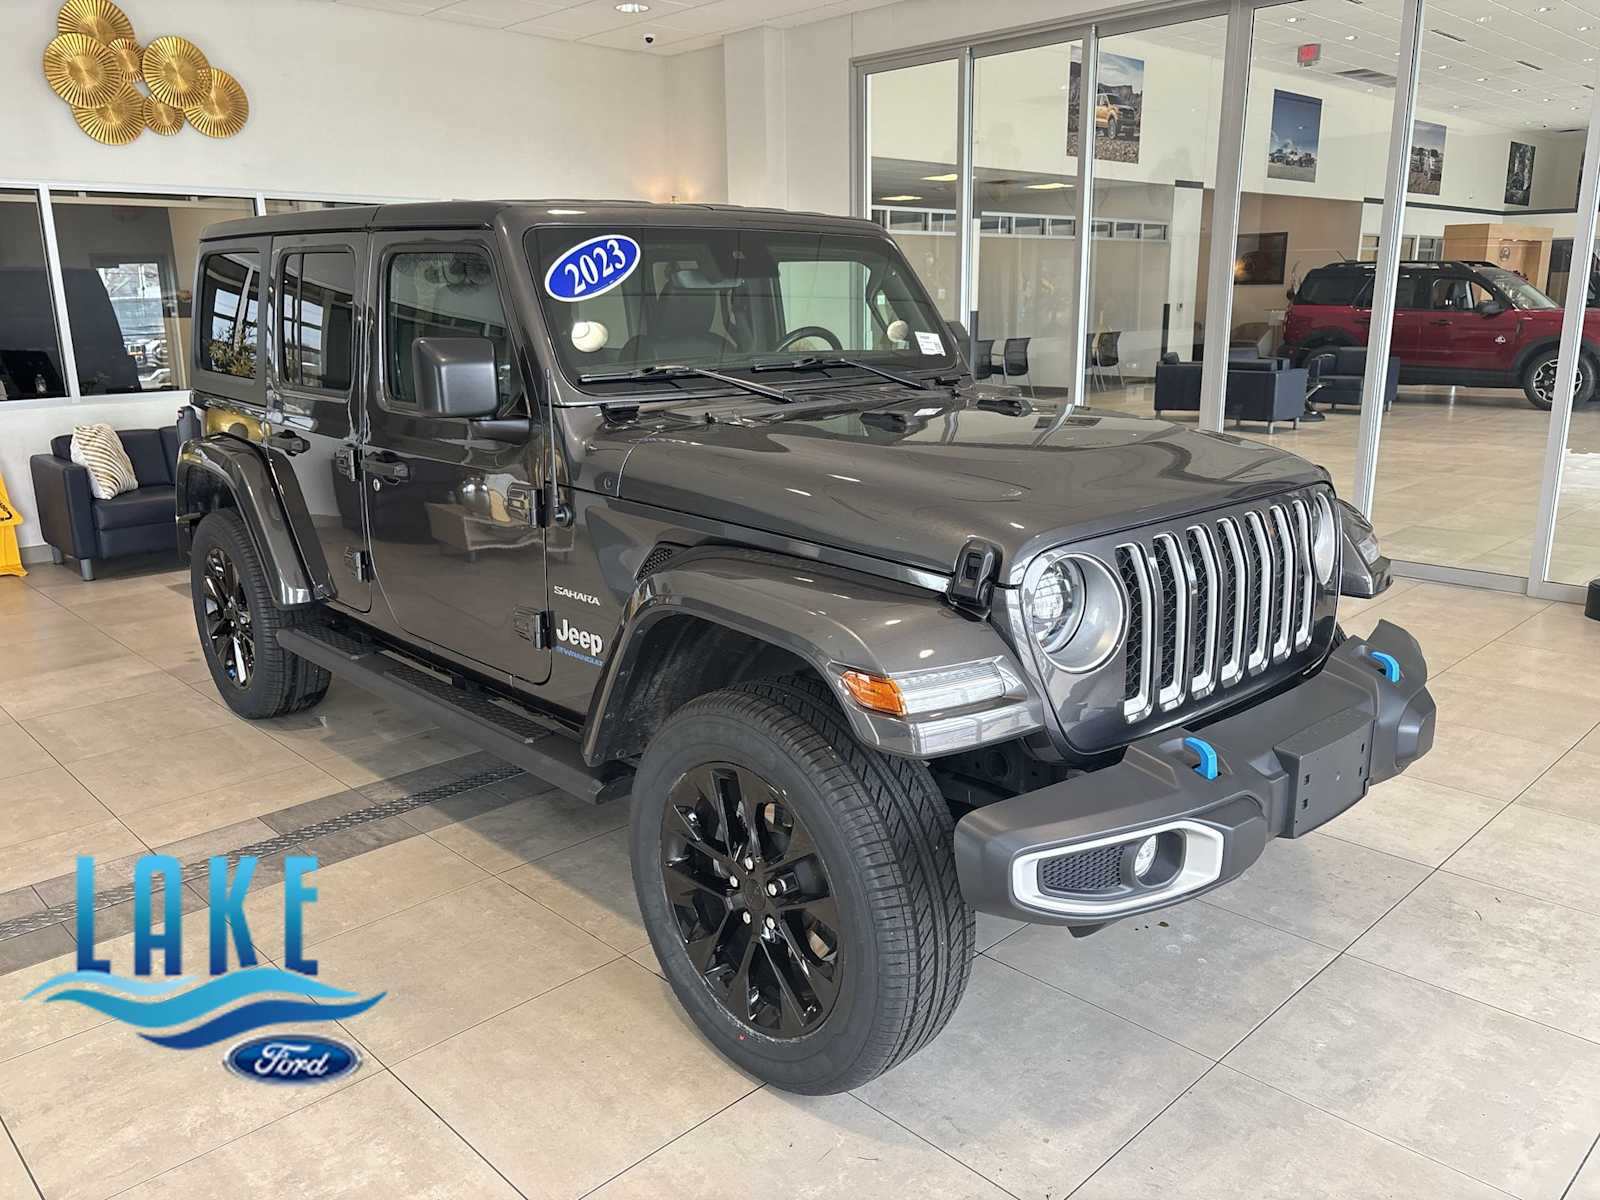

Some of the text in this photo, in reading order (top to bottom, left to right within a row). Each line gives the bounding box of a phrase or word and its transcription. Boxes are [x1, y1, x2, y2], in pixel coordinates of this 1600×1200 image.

[564, 239, 626, 295] 2023
[554, 585, 600, 606] SAHARA
[556, 618, 602, 656] Jeep
